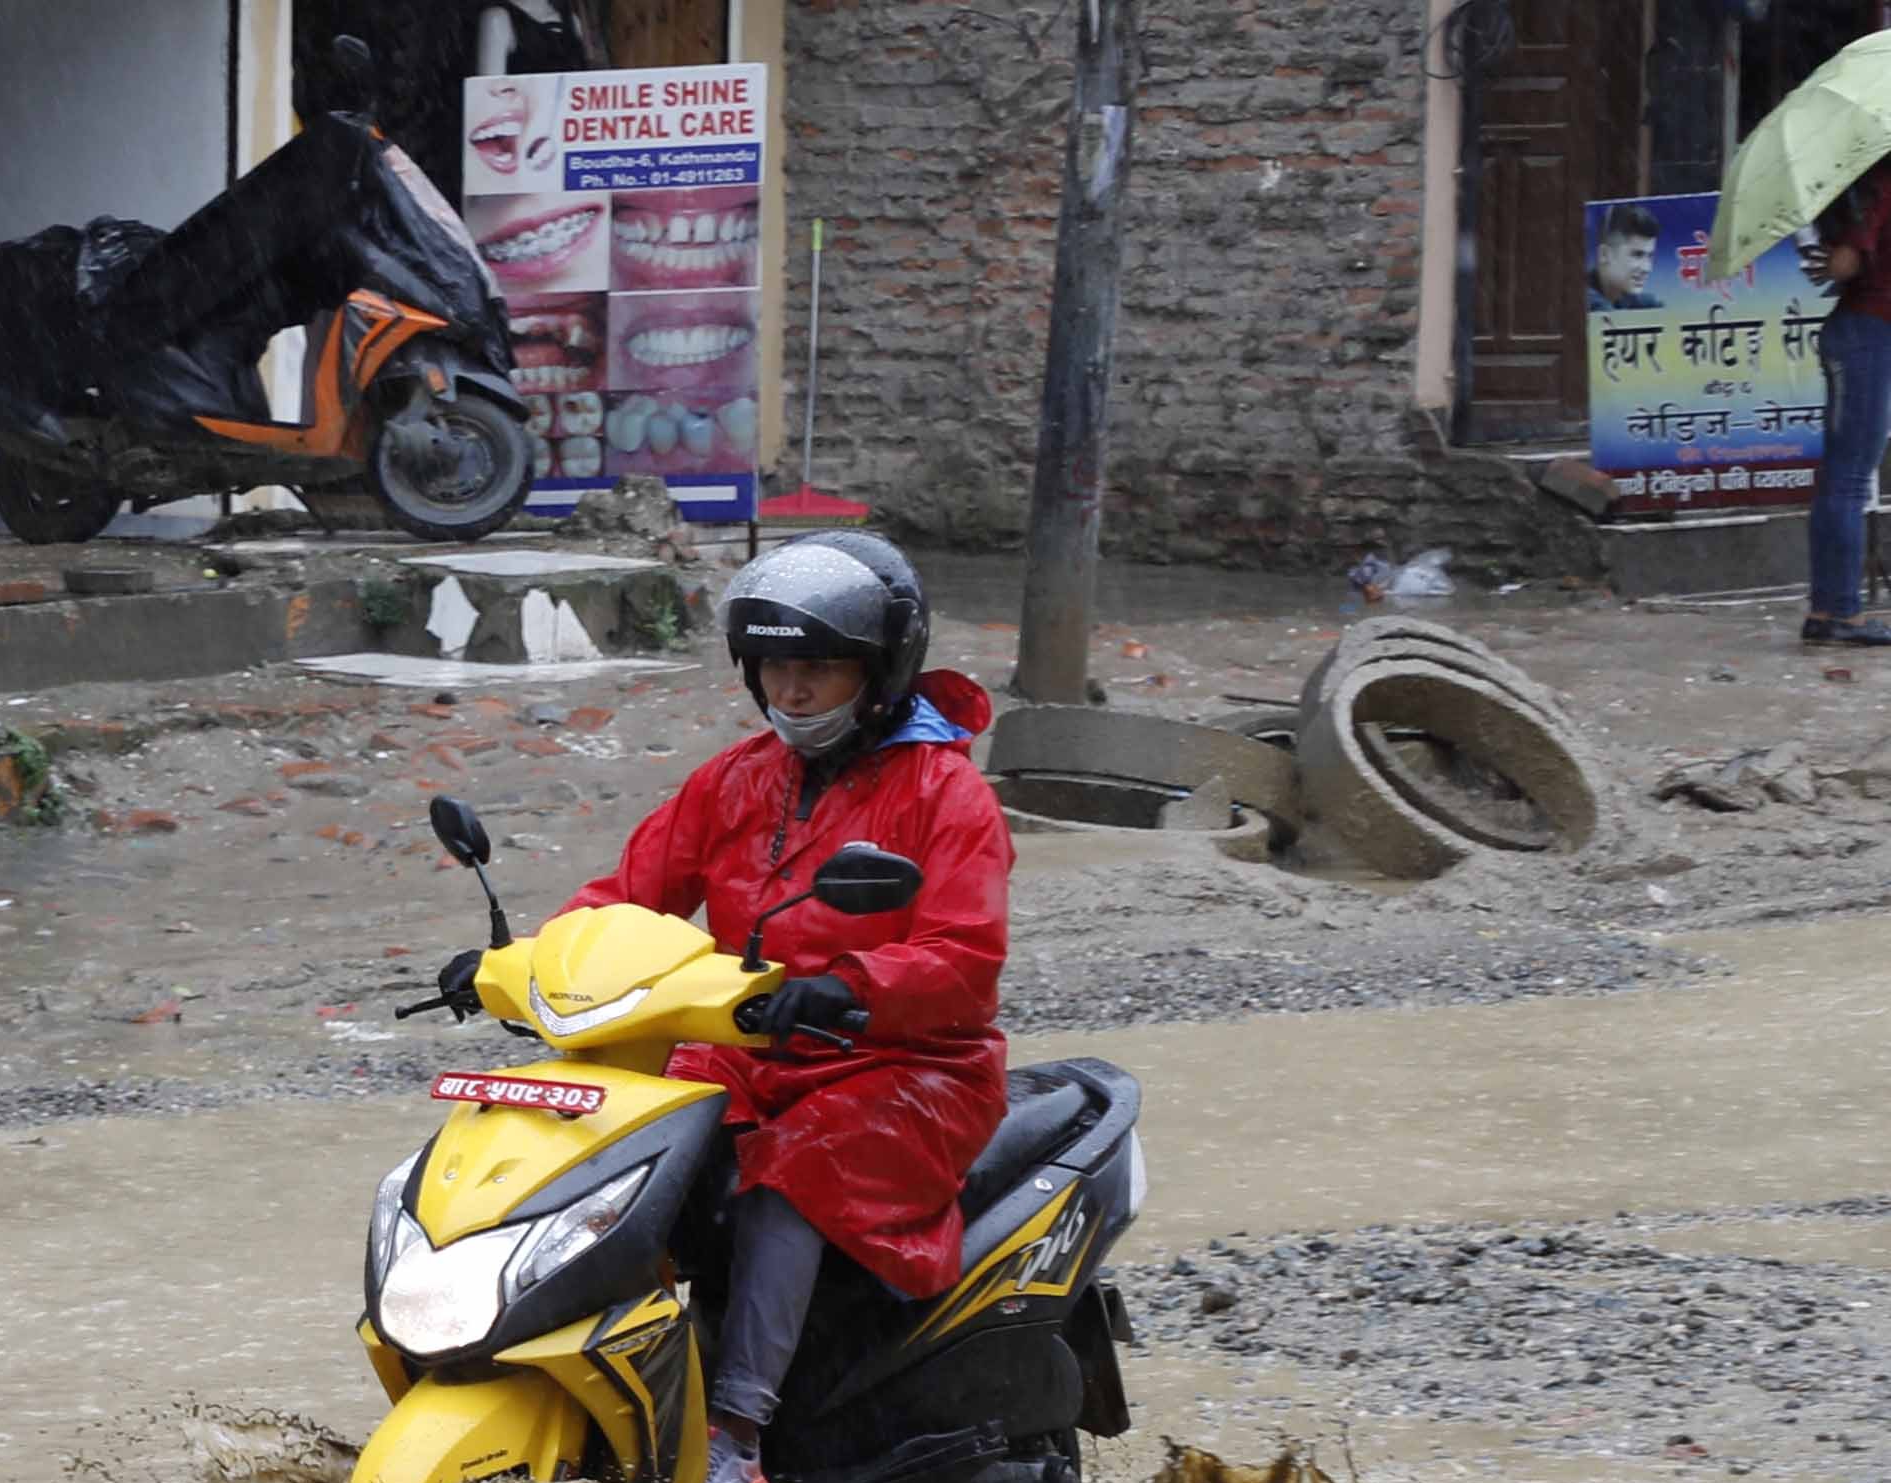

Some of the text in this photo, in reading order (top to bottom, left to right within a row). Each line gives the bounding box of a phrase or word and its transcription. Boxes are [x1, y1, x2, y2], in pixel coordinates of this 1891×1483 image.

[570, 79, 747, 111] SMILE SHINE
[563, 110, 754, 142] DENTAL CARE
[659, 150, 756, 166] Kathmandu
[580, 174, 609, 188] Ph.
[746, 624, 806, 637] HONDA
